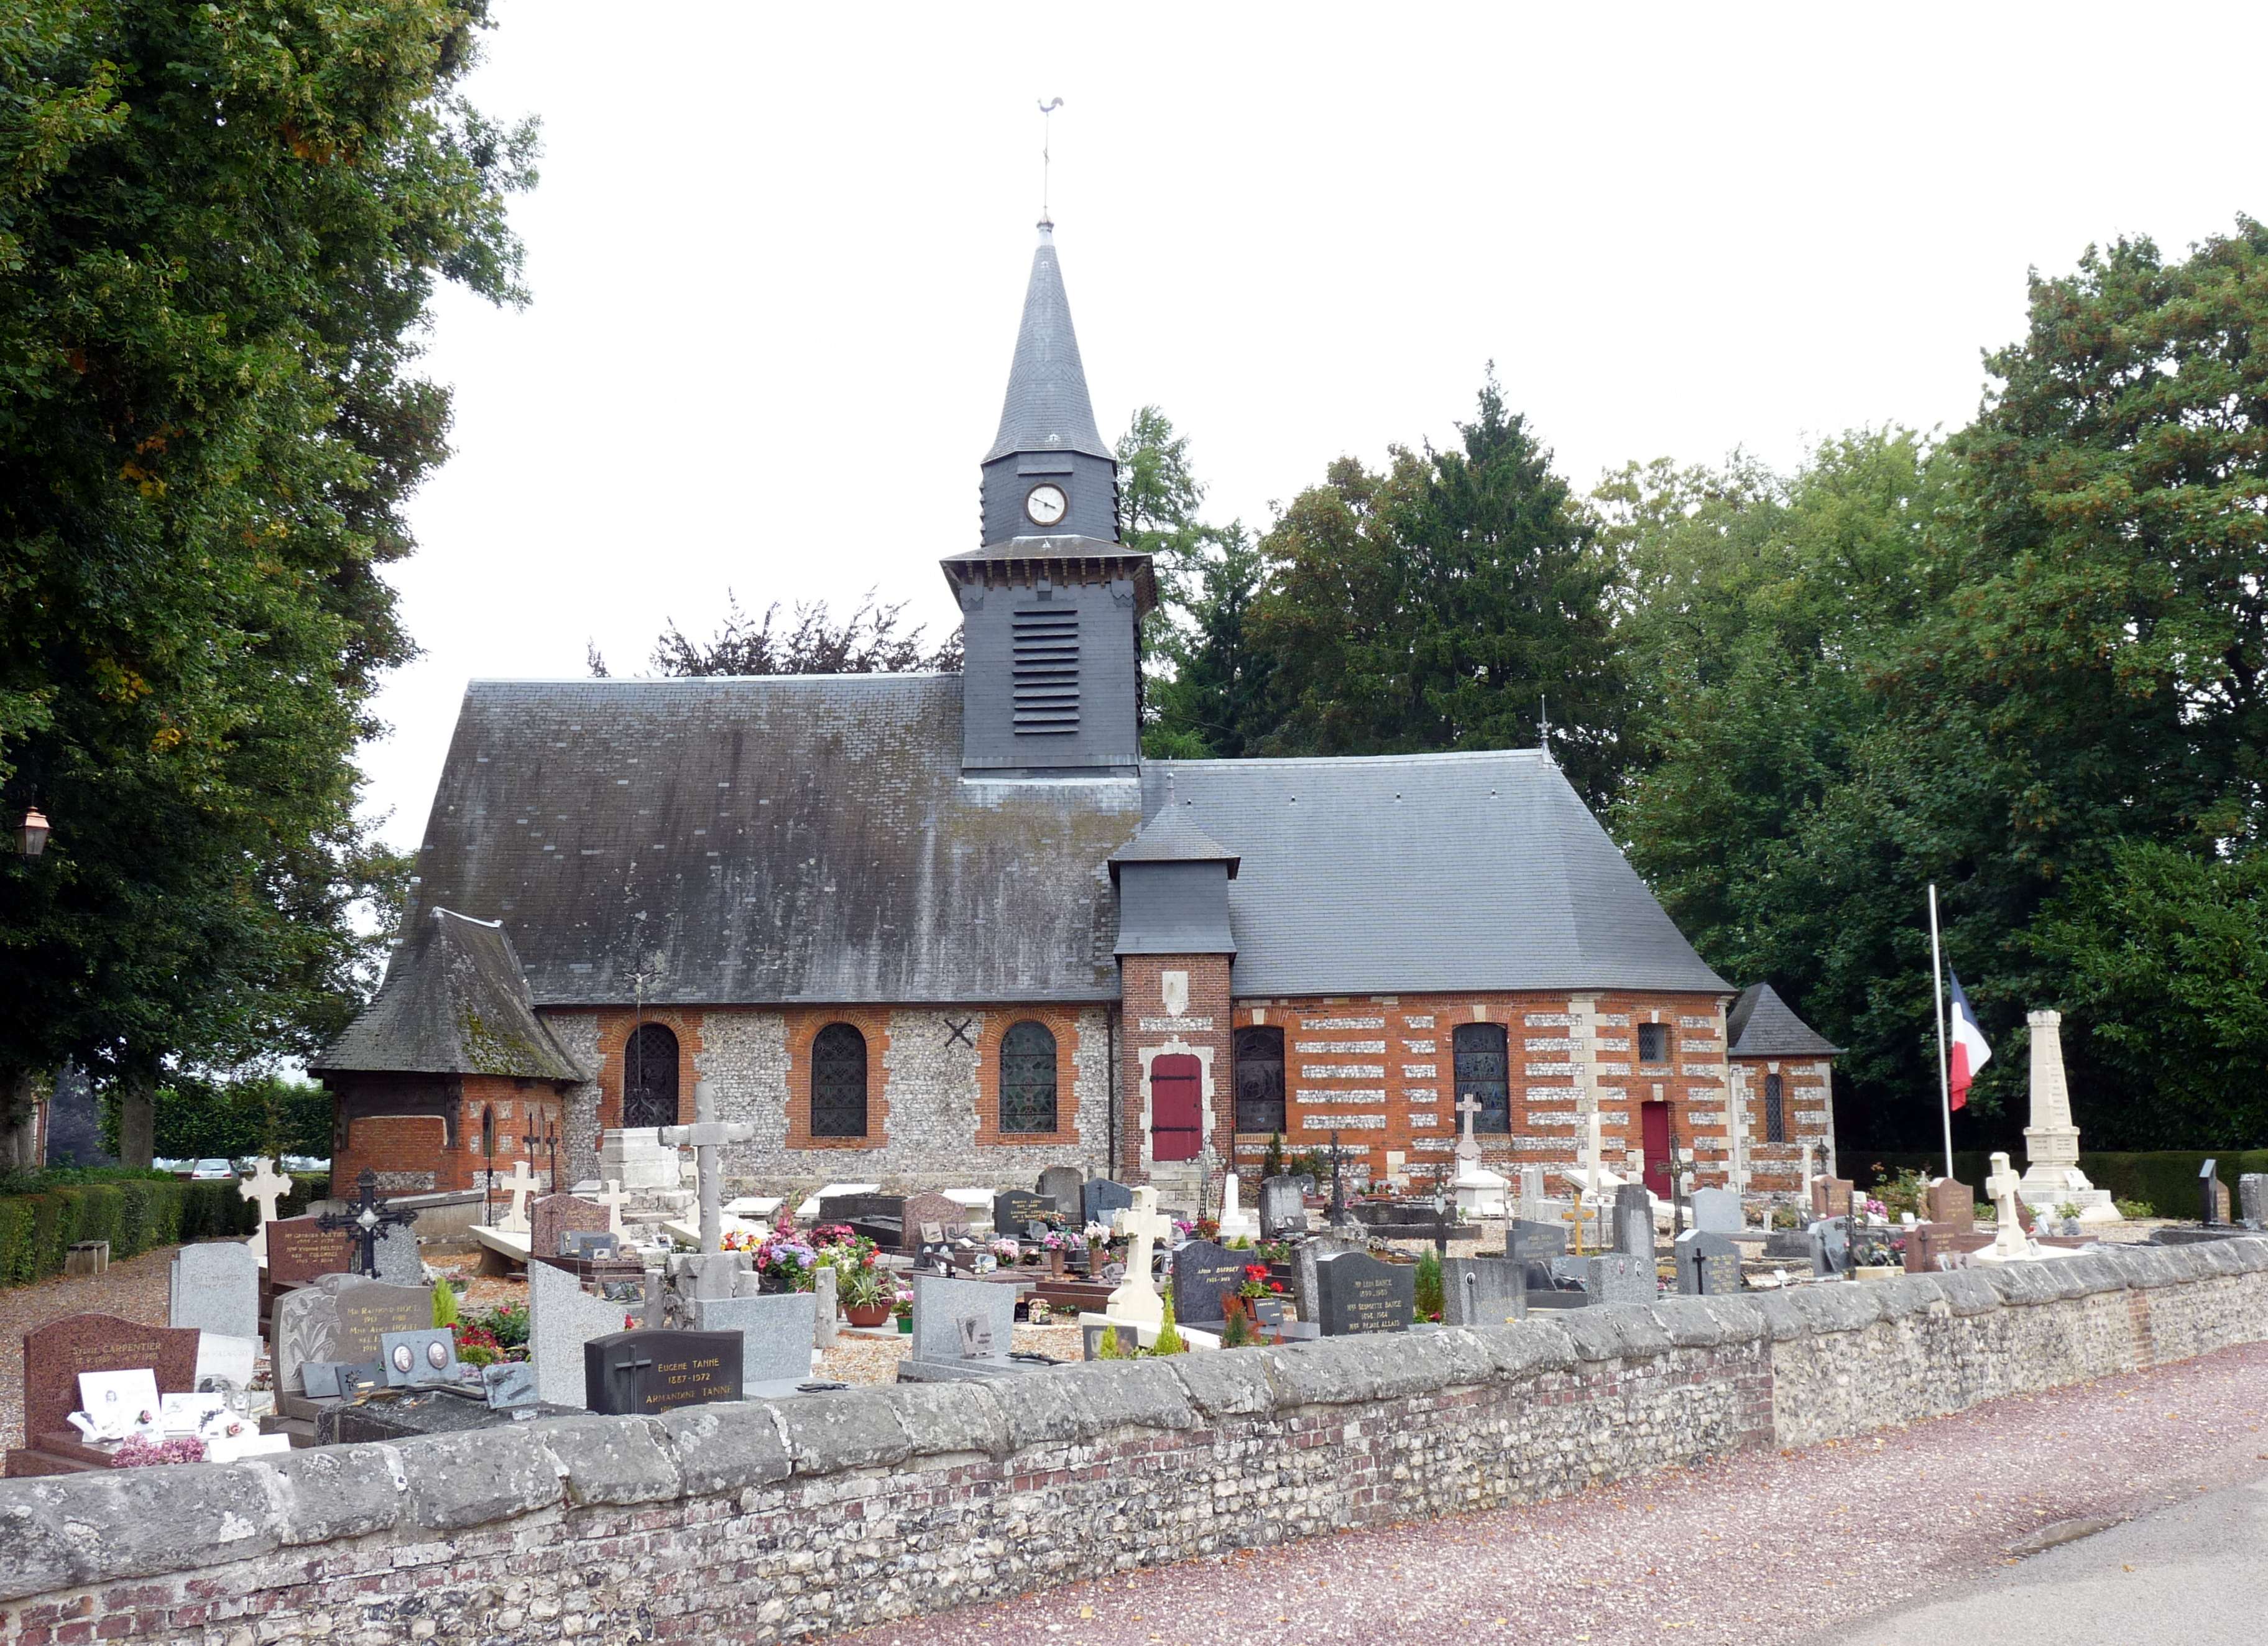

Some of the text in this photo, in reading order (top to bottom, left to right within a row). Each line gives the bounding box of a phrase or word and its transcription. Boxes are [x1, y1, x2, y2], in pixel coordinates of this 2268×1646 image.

[72, 1343, 161, 1355] SYLVIE CARPENTIER
[692, 1357, 720, 1368] TANNE
[646, 1390, 696, 1403] ARMANDINE
